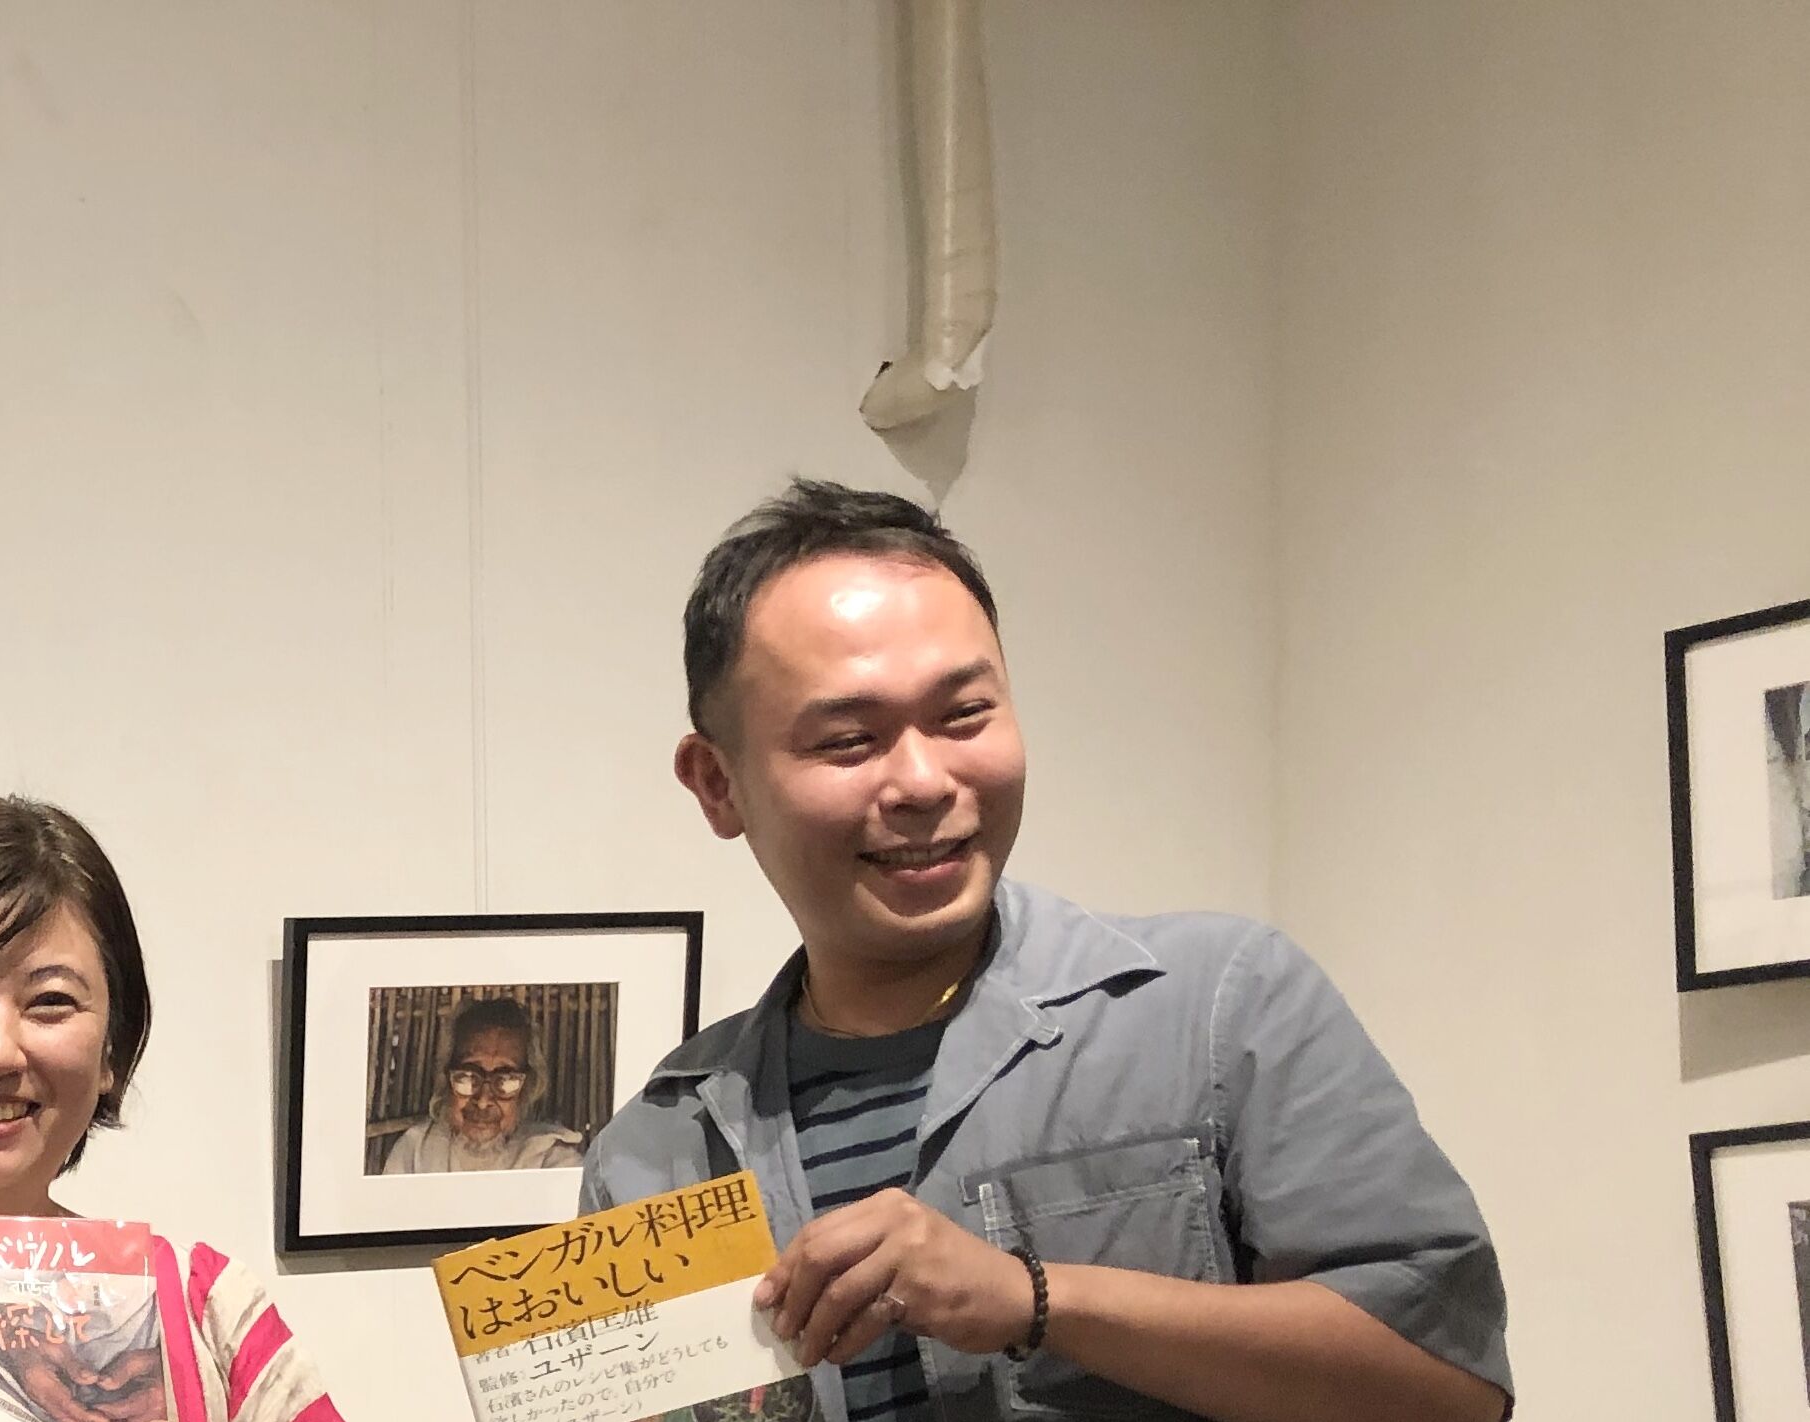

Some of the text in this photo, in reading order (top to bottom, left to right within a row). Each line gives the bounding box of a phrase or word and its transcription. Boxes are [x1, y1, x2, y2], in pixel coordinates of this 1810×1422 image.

[450, 1179, 757, 1284] ベンガル料理
[459, 1253, 690, 1339] はおいしい
[529, 1331, 659, 1380] ユザーン
